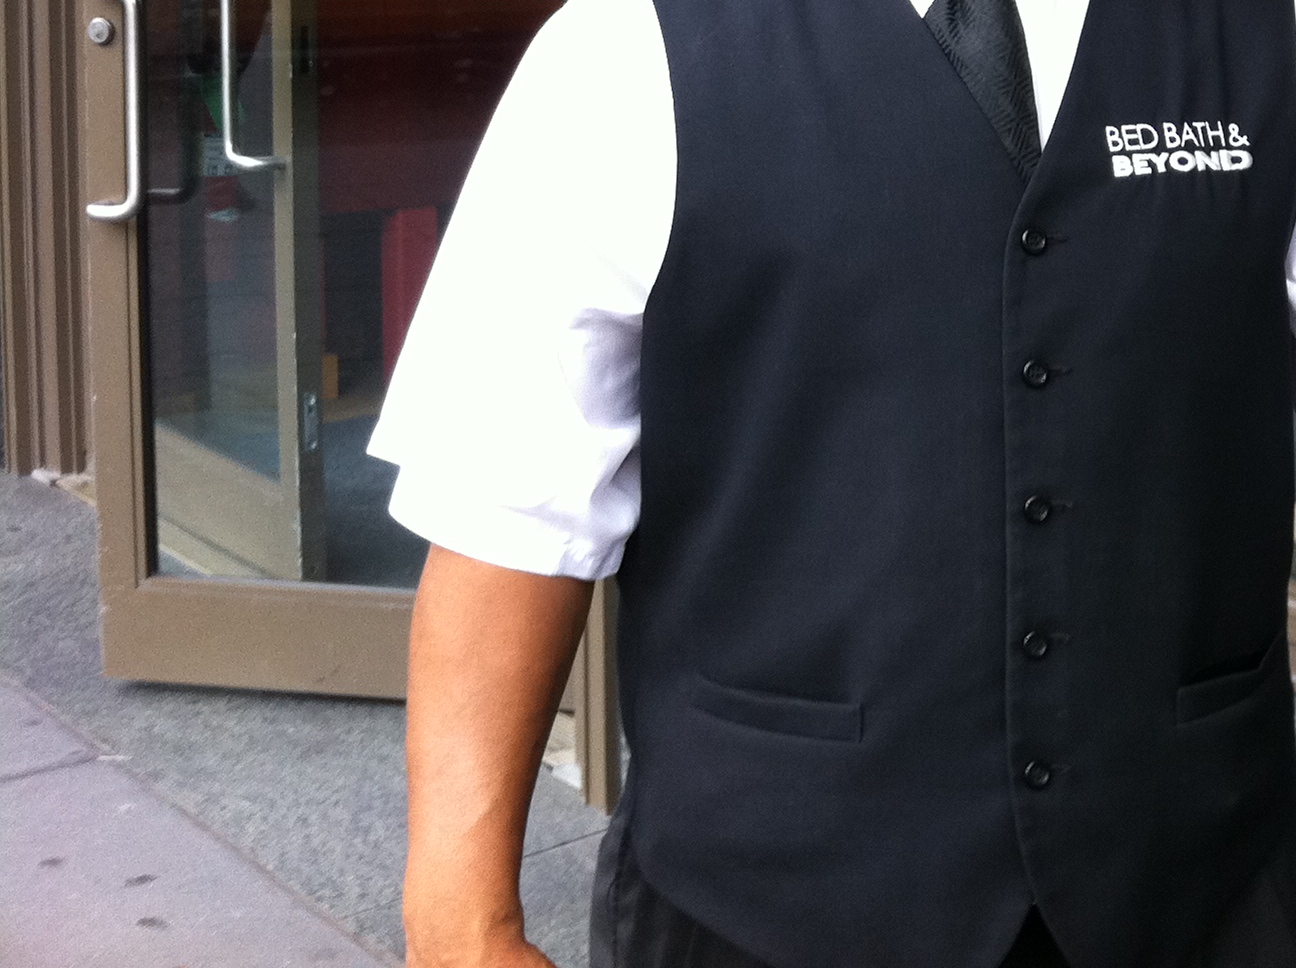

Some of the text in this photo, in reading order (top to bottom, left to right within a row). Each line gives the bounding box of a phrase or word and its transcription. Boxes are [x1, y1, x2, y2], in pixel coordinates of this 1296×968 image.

[1105, 120, 1251, 153] BED BATH &
[1111, 149, 1253, 178] BEYOND
